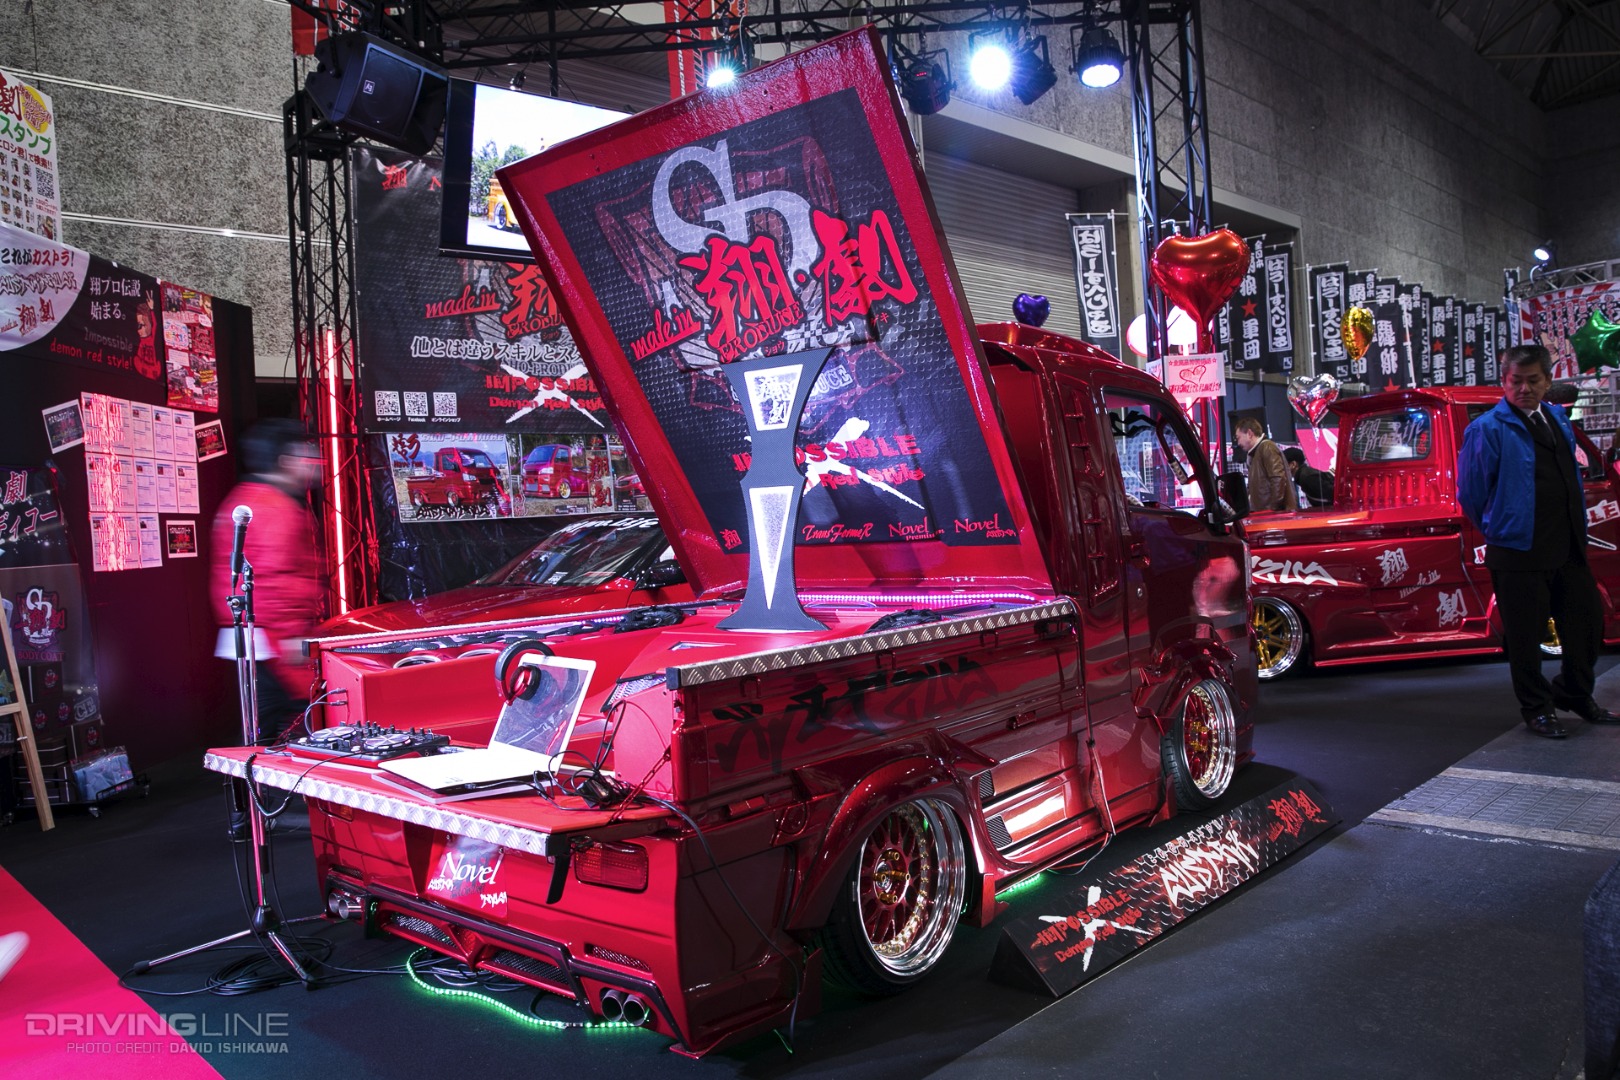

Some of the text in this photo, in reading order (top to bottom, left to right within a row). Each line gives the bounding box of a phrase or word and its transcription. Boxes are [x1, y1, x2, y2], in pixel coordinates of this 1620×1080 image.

[1, 247, 75, 267] これがカストラ!
[90, 276, 141, 298] 翔プロ伝説
[91, 301, 127, 321] 始まる。
[426, 285, 500, 318] made in
[1268, 258, 1289, 349] はろーすぺしゃる
[1321, 275, 1343, 358] はろーすぺしゃる
[84, 326, 134, 352] Impossible
[631, 306, 700, 358] made in
[719, 302, 804, 364] PRODUCE
[50, 338, 133, 370] demon red style!
[764, 341, 785, 356] ショウ
[888, 516, 929, 538] Novel
[905, 528, 946, 541] Premium
[953, 512, 1000, 534] Novel
[439, 851, 502, 885] Novel
[1036, 889, 1132, 947] IMPOSSIBLE
[1054, 937, 1095, 963] Demon
